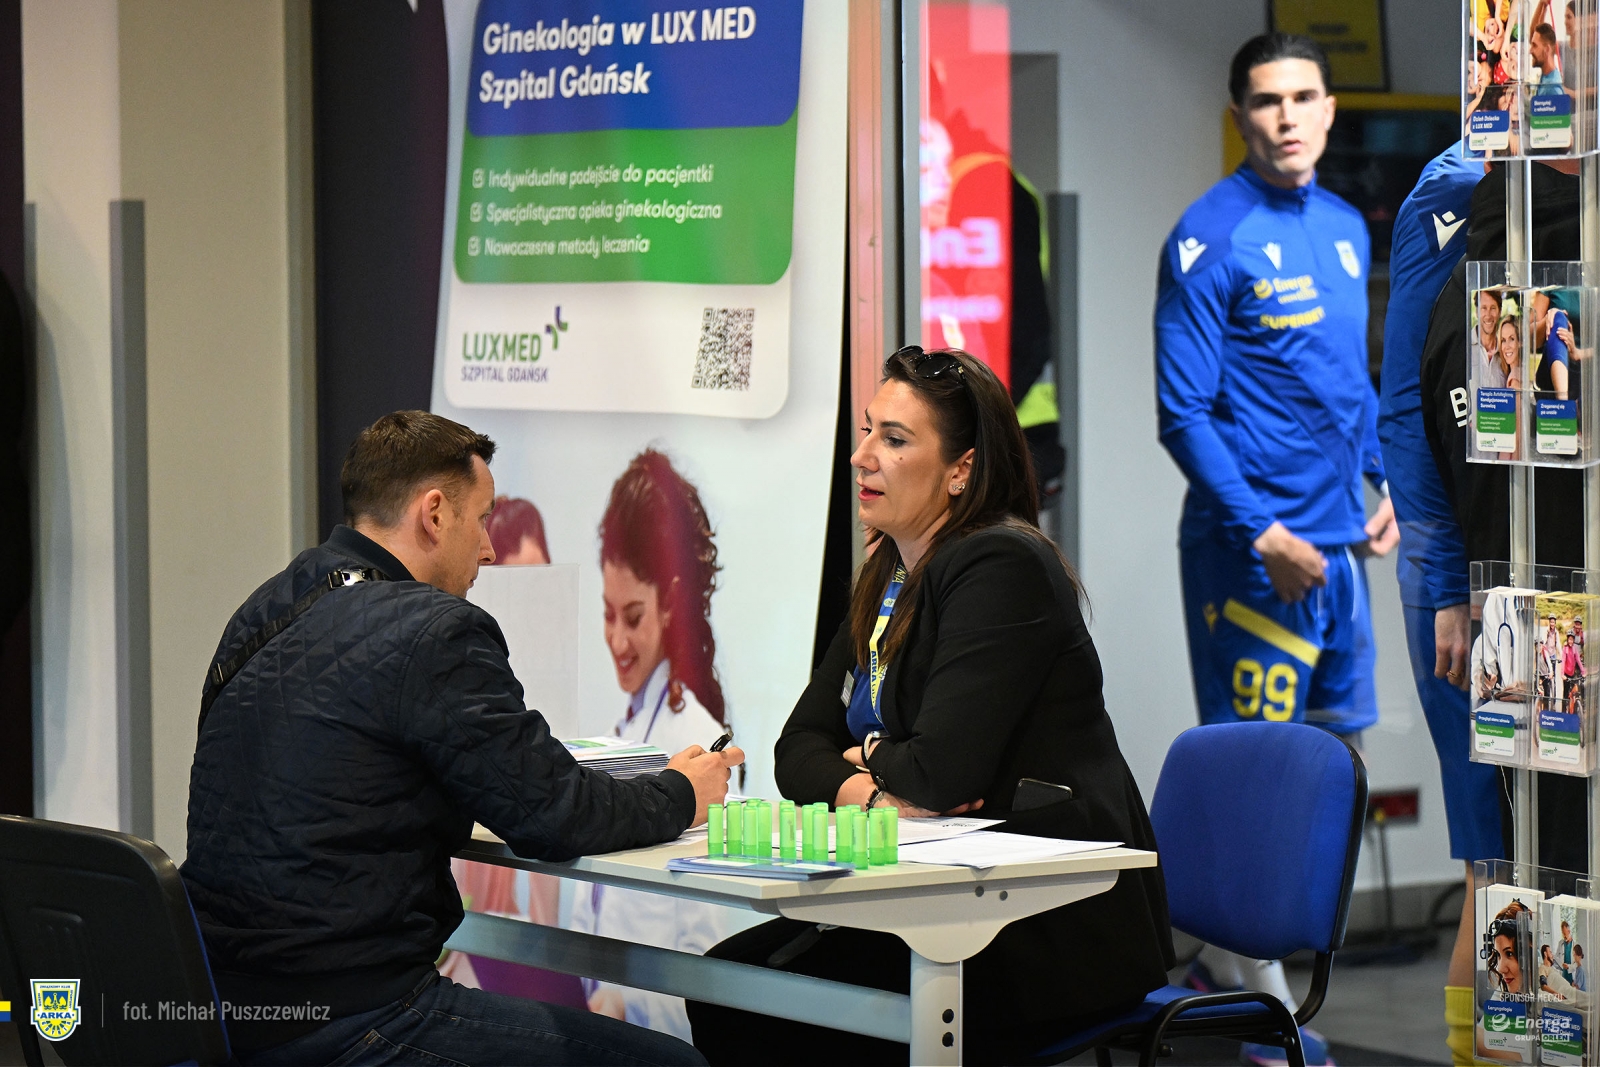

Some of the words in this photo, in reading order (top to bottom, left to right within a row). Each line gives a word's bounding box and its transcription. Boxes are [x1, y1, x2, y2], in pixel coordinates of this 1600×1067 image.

[483, 15, 613, 56] Ginekologia
[621, 22, 646, 45] w
[650, 10, 697, 45] LUX
[701, 6, 757, 41] MED
[479, 68, 555, 109] Szpital
[559, 61, 652, 98] Gdańsk
[488, 168, 566, 192] Indywidualne
[569, 166, 619, 189] podejście
[622, 164, 641, 183] do
[645, 164, 713, 188] pacjentki
[486, 202, 576, 226] Specjalistyczna
[578, 201, 613, 223] opieka
[615, 198, 722, 224] ginekologiczna
[484, 237, 555, 256] Nowoczesne
[557, 236, 599, 259] metody
[601, 233, 650, 253] leczenia
[462, 333, 541, 362] LUXMED
[461, 367, 504, 382] SZPITAL
[507, 364, 549, 382] GDAŃSK
[1232, 658, 1298, 722] 99
